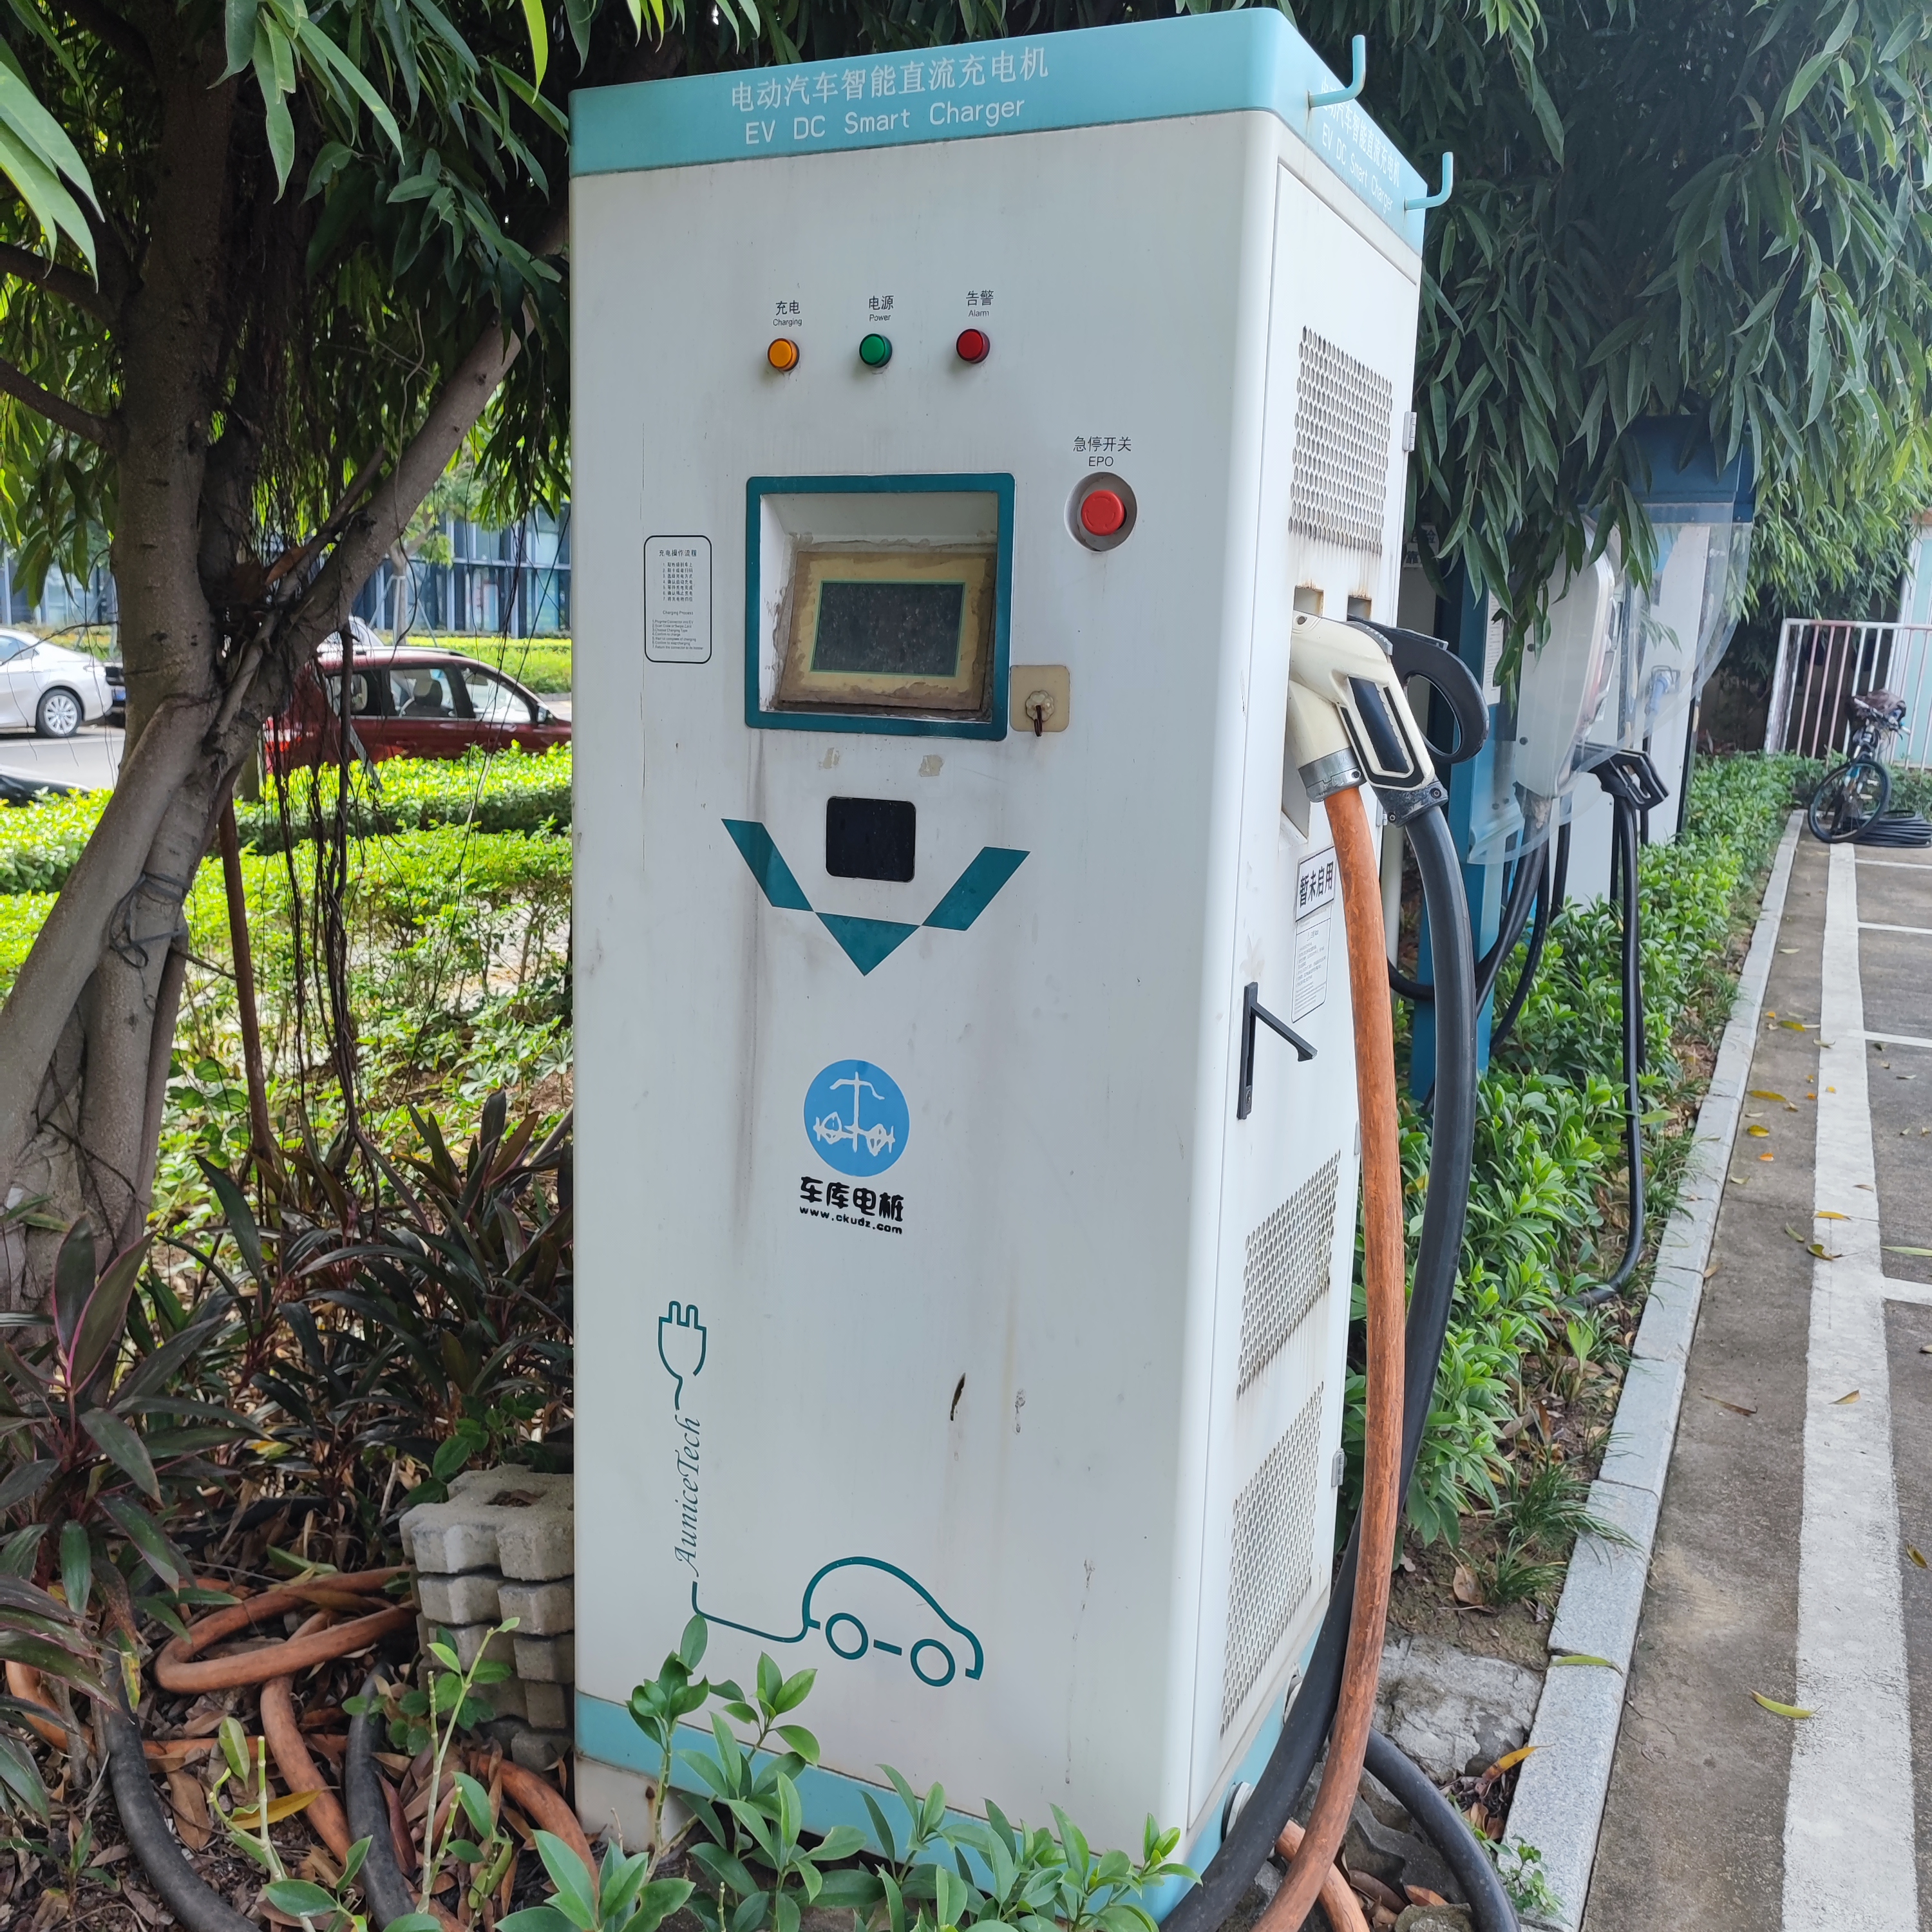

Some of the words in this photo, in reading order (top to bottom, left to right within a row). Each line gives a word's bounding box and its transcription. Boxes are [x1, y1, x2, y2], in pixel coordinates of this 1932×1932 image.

[732, 47, 1048, 111] 电动汽车智能直流充电机
[746, 120, 776, 145] EV
[794, 115, 826, 140] DC
[844, 108, 911, 135] Smart
[929, 100, 1025, 128] Charger
[1322, 122, 1333, 151] EV
[1336, 138, 1347, 166] DC
[1350, 153, 1368, 188] Smart
[1371, 175, 1394, 214] Charger
[869, 295, 895, 310] 电源
[966, 290, 994, 307] 告警
[775, 300, 800, 316] 充电
[968, 309, 990, 317] Alarm
[773, 318, 802, 327] Charging
[869, 314, 891, 322] Power
[1073, 435, 1132, 452] 急停开关
[1088, 456, 1114, 467] EPO
[1300, 860, 1334, 909] 暂未启用
[800, 1176, 904, 1222] 车库电桩
[799, 1206, 903, 1235] www.ckudz.com
[674, 1414, 700, 1578] AuniceTech
